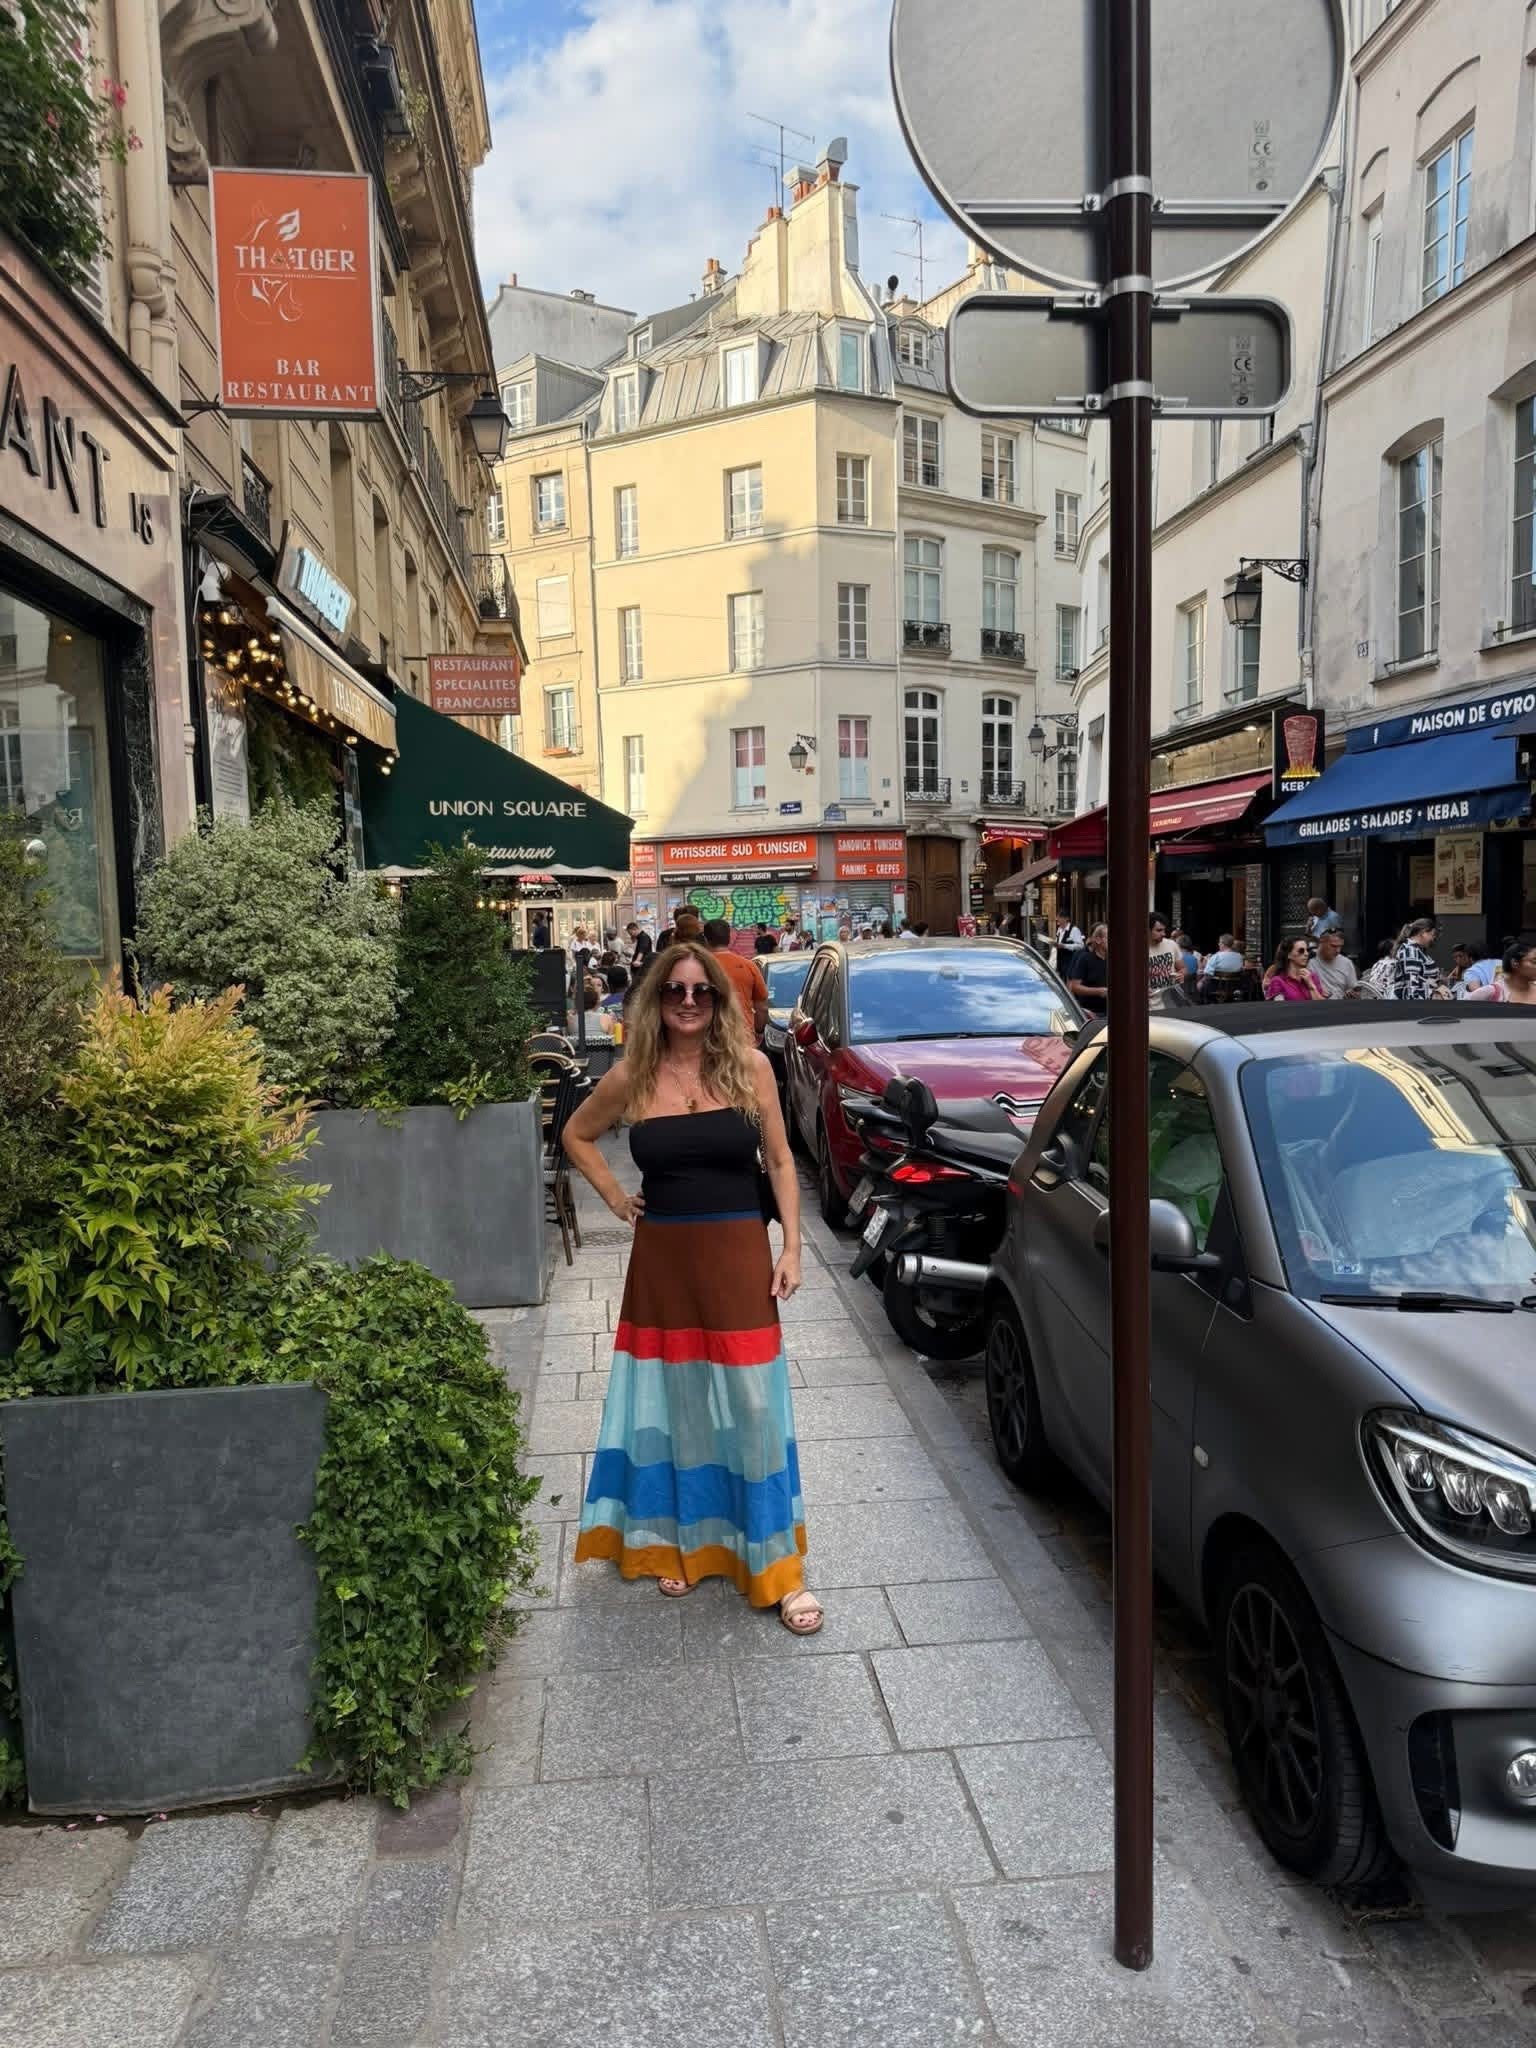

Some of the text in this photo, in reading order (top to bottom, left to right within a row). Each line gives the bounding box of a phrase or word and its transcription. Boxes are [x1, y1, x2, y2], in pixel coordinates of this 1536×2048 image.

[277, 359, 320, 376] BAR
[227, 382, 373, 402] RESTAURANT
[129, 492, 154, 544] 18
[433, 659, 513, 671] RESTAURANT
[435, 679, 517, 690] SPECIALITES
[1411, 711, 1464, 735] MAISON
[1468, 704, 1486, 724] DE
[429, 800, 587, 817] UNION SQUARE
[1299, 801, 1469, 837] GRILLADES SALADES KEBAB
[670, 844, 727, 859] PATISSERIE
[731, 843, 752, 857] SUD
[756, 840, 807, 855] TUNISIEN
[837, 839, 903, 851] SANDWICH TUNISIEN
